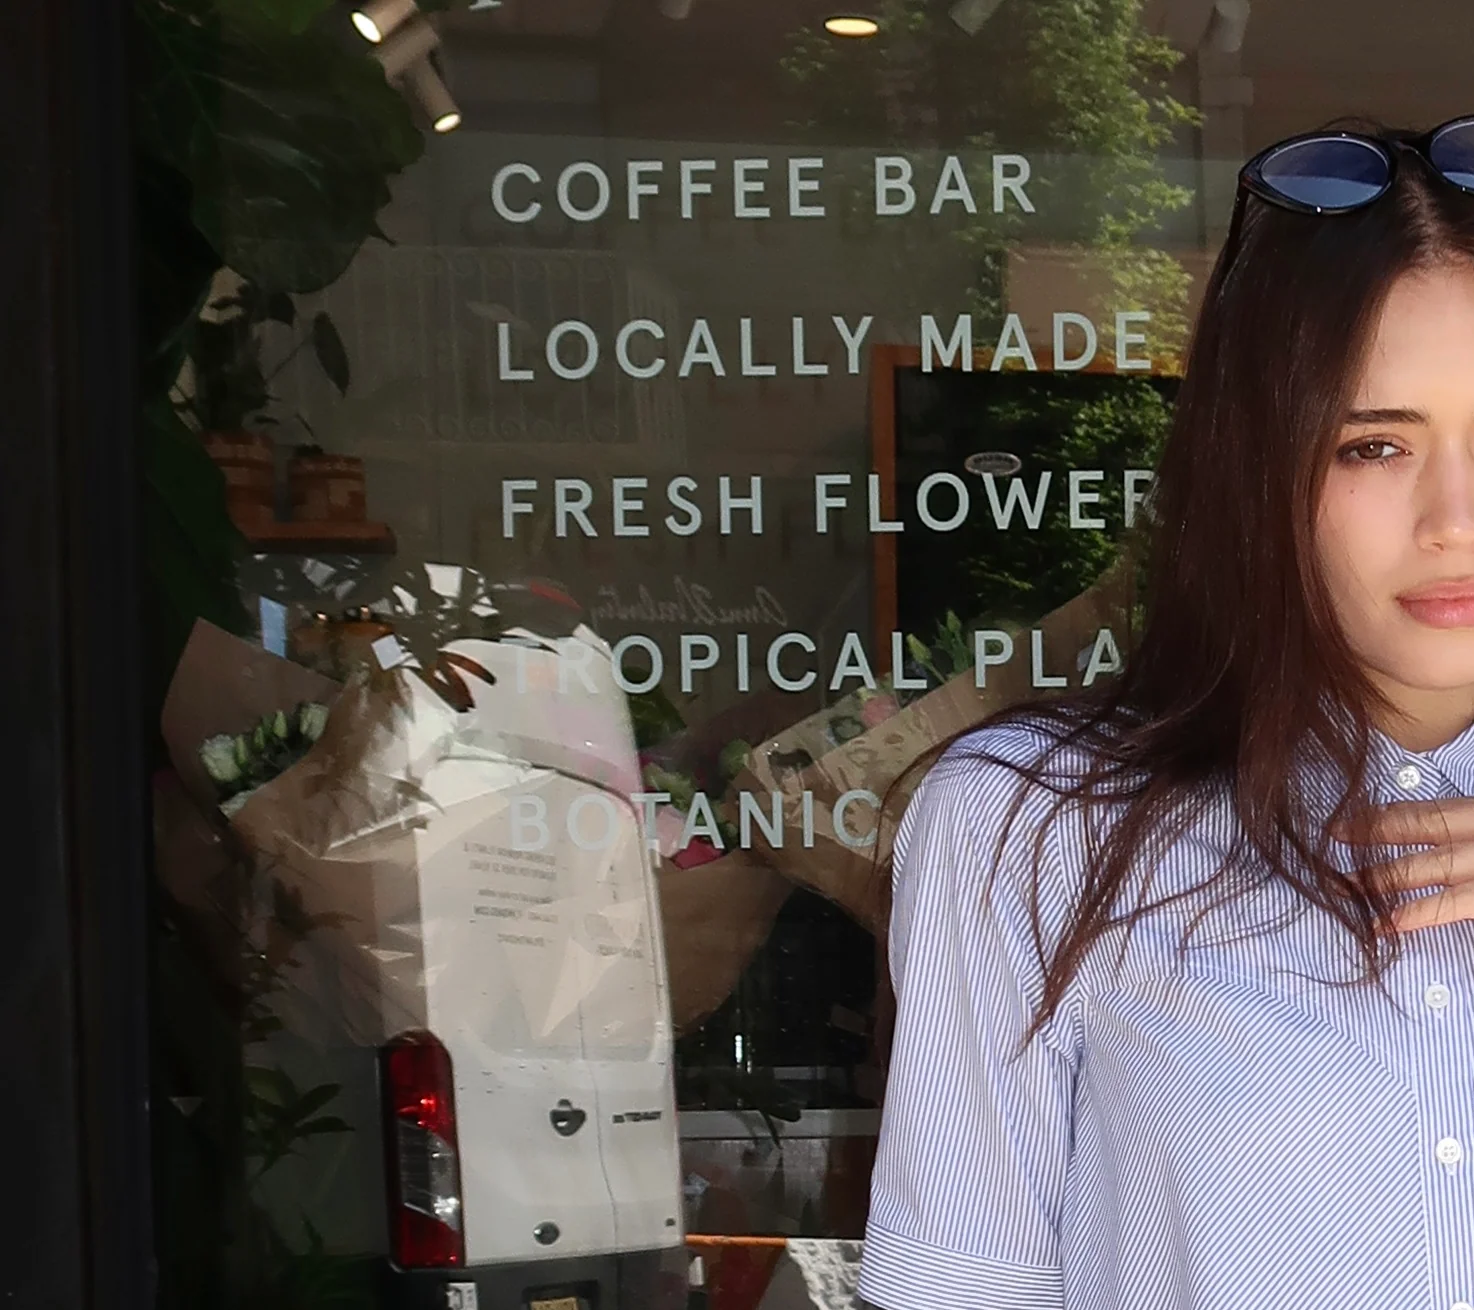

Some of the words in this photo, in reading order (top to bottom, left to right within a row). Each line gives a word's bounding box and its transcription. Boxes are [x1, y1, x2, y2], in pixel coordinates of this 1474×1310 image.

[490, 157, 825, 223] COFFEE
[875, 154, 1036, 217] BAR
[497, 315, 874, 380] LOCALLY
[920, 311, 1152, 373] MADE
[502, 475, 764, 538] FRESH
[500, 631, 927, 693] TROPICAL
